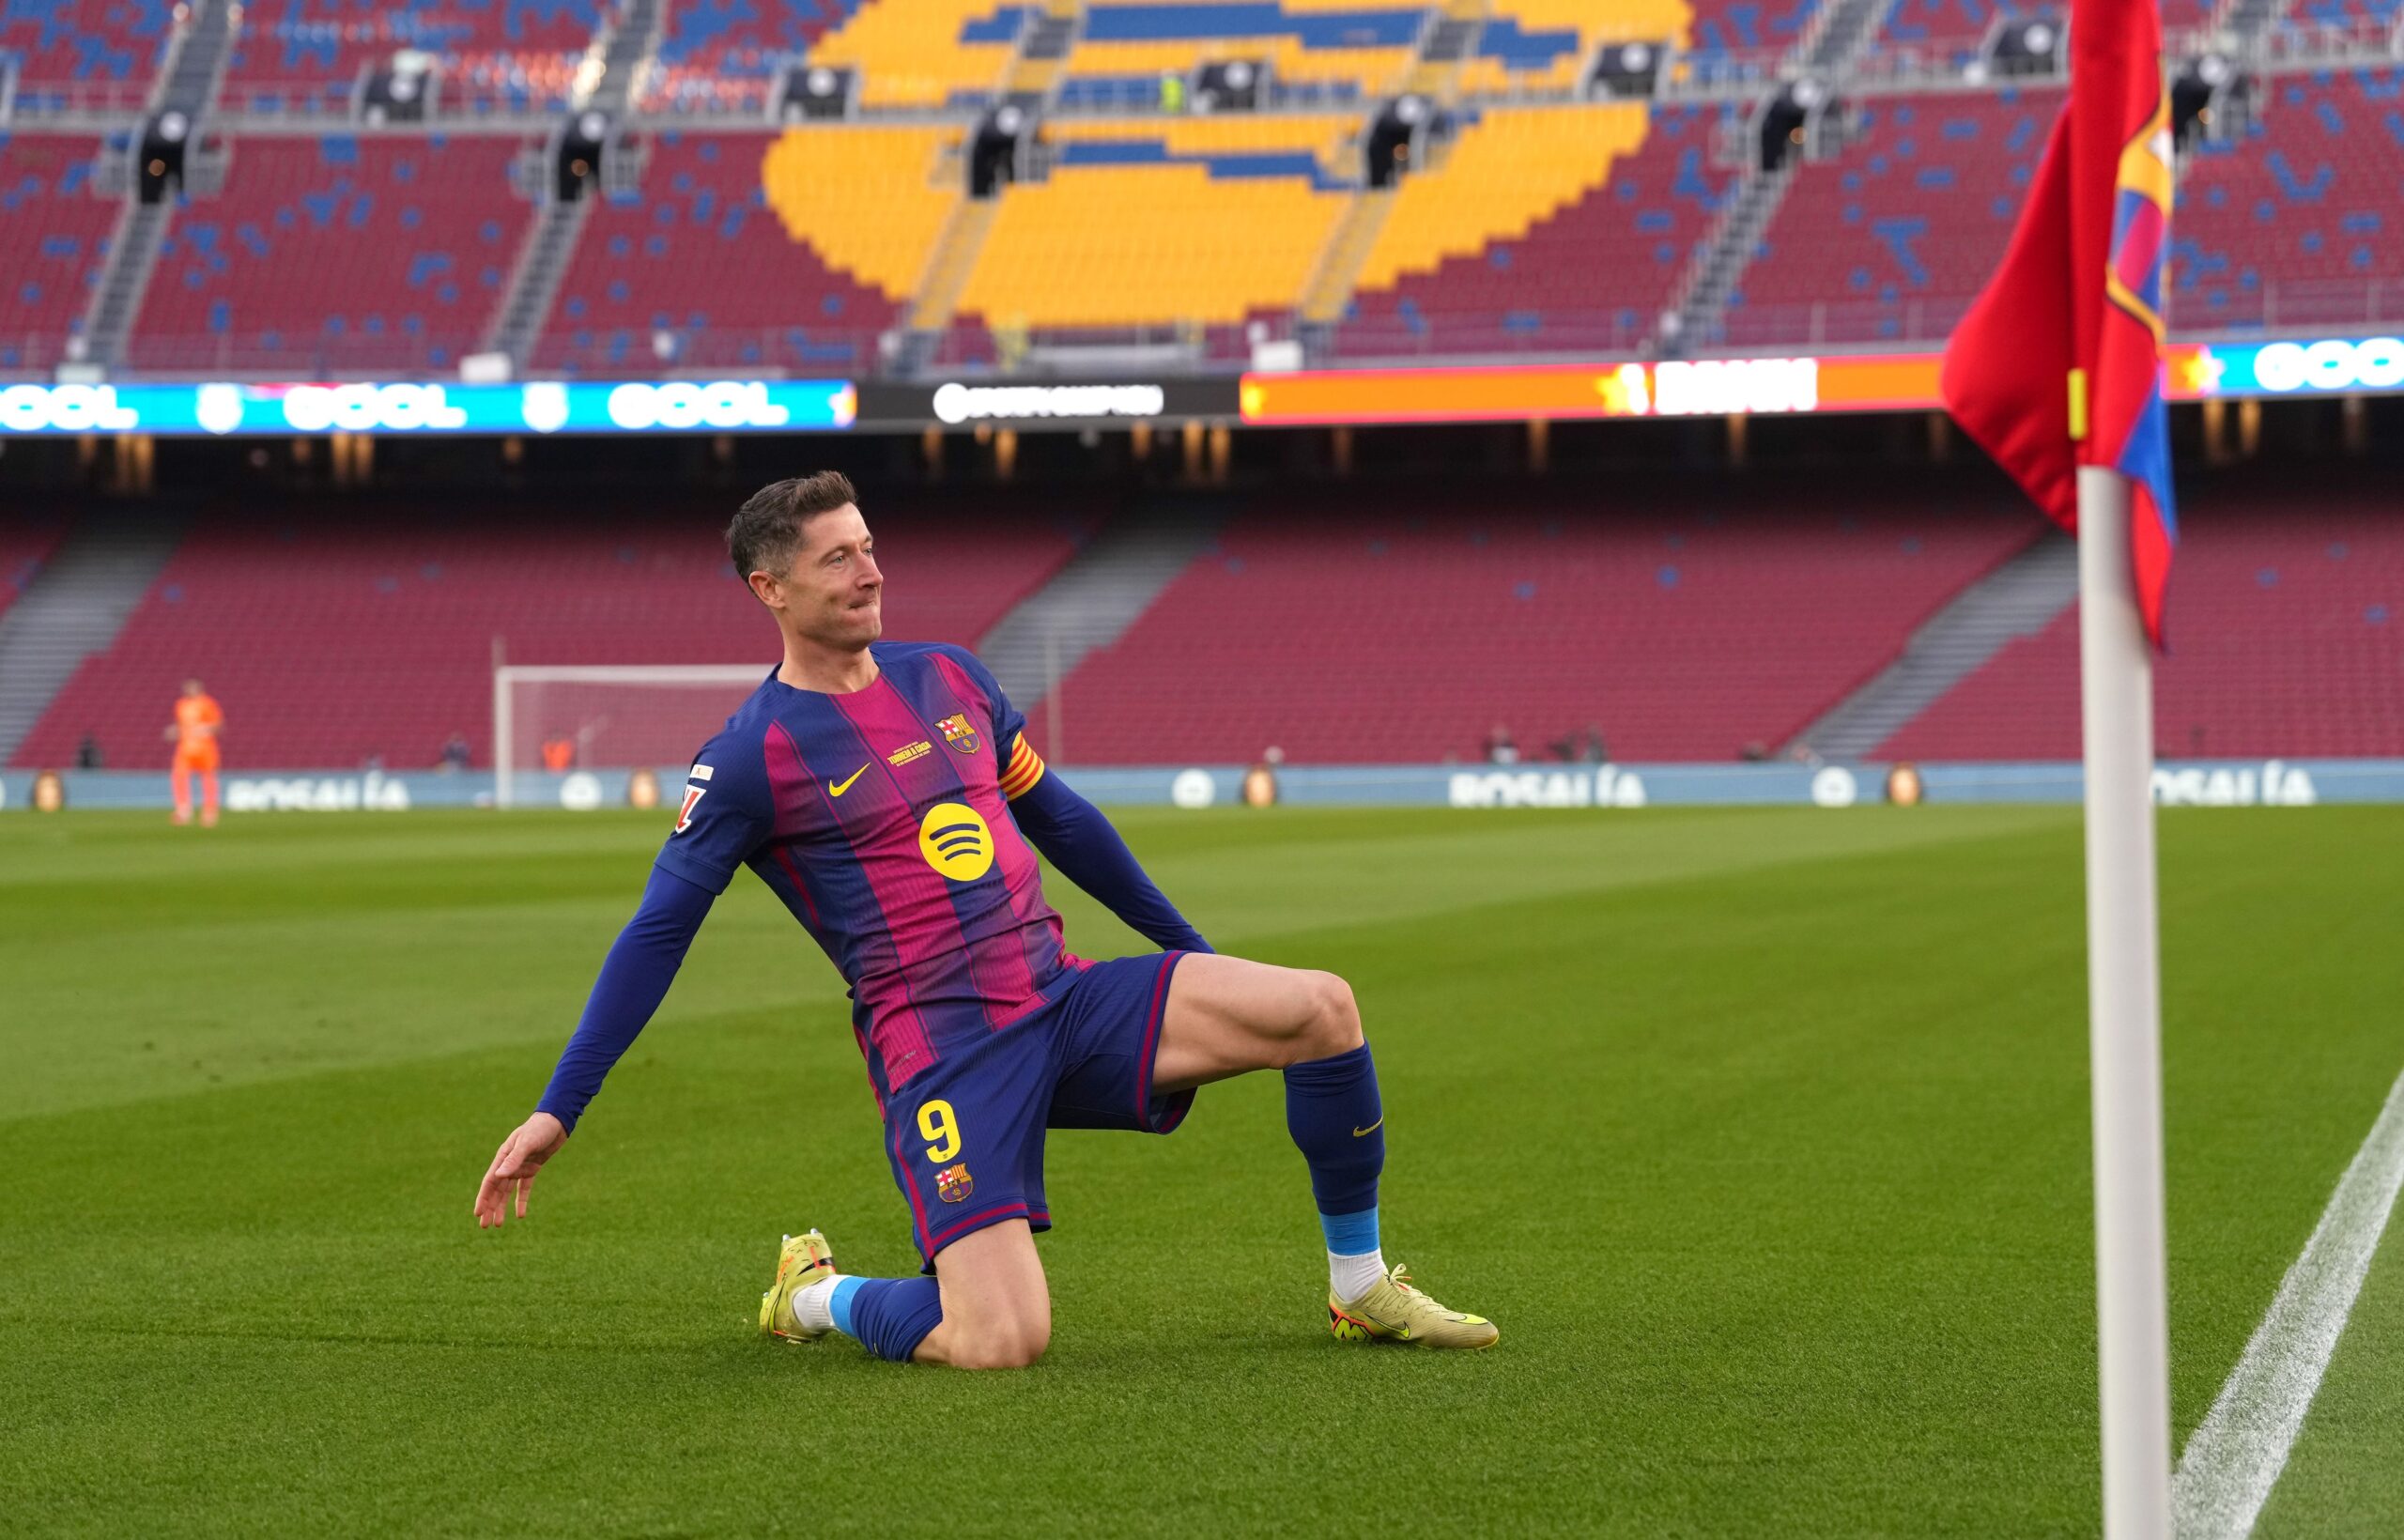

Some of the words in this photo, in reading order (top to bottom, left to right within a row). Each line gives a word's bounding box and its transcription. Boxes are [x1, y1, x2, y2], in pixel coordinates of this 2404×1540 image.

[2254, 337, 2404, 392] GOO
[0, 384, 138, 430] OOL
[917, 1100, 962, 1163] 9
